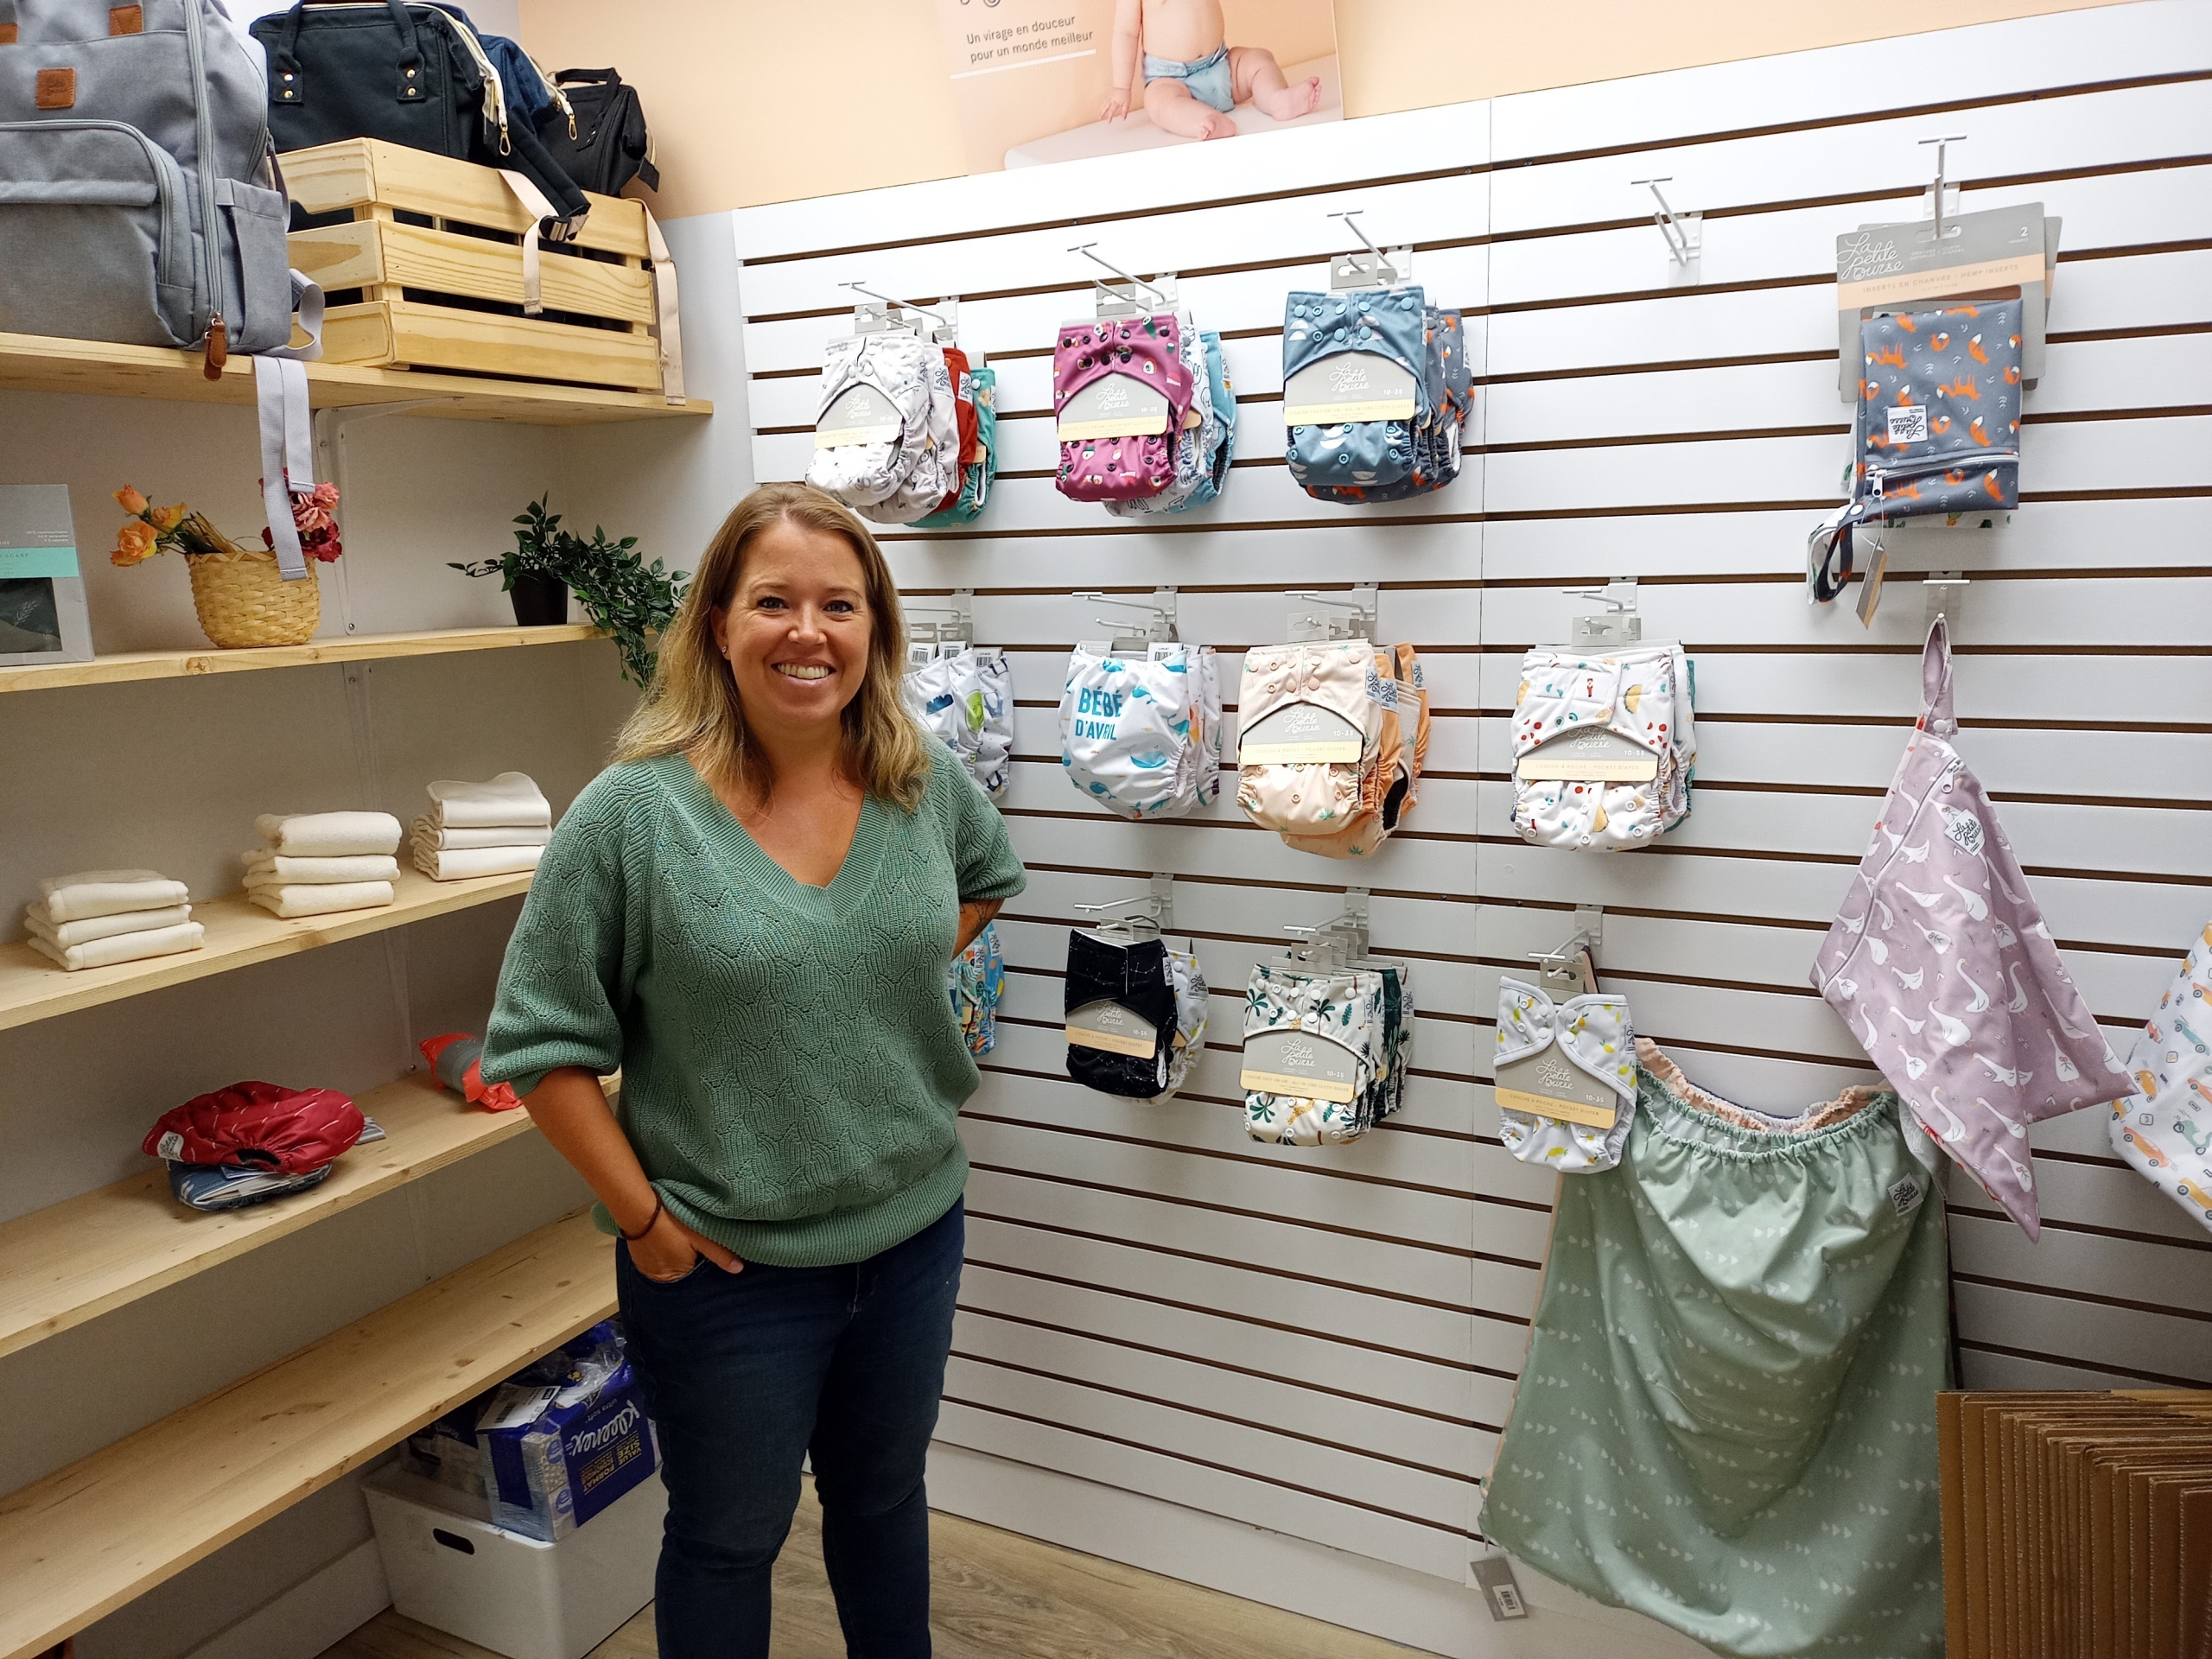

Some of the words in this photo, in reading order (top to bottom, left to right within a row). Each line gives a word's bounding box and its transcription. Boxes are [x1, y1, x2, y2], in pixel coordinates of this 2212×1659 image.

[966, 34, 981, 45] Un
[983, 29, 1014, 41] virage
[1016, 25, 1029, 35] en
[1032, 16, 1076, 33] douceur
[970, 49, 994, 64] pour
[997, 47, 1010, 57] un
[1013, 40, 1048, 54] monde
[1051, 31, 1093, 48] meilleur
[2020, 226, 2029, 238] 2
[1837, 232, 1871, 264] La
[1840, 240, 1897, 280] petite
[1863, 283, 1897, 293] INSERTS
[1912, 275, 1950, 285] CHANVRE
[1961, 270, 1983, 278] HEMP
[1985, 264, 2019, 275] INSERTS
[1078, 686, 1123, 717] BÉBÉ
[1075, 719, 1116, 741] D'AVRIL
[1586, 1094, 1604, 1103] 10-35
[588, 1409, 601, 1421] soft
[602, 1398, 618, 1411] ultra
[571, 1400, 640, 1457] Kleenex
[617, 1439, 640, 1459] SIZE
[619, 1448, 642, 1465] VALUE
[583, 1463, 615, 1493] FORMAT
